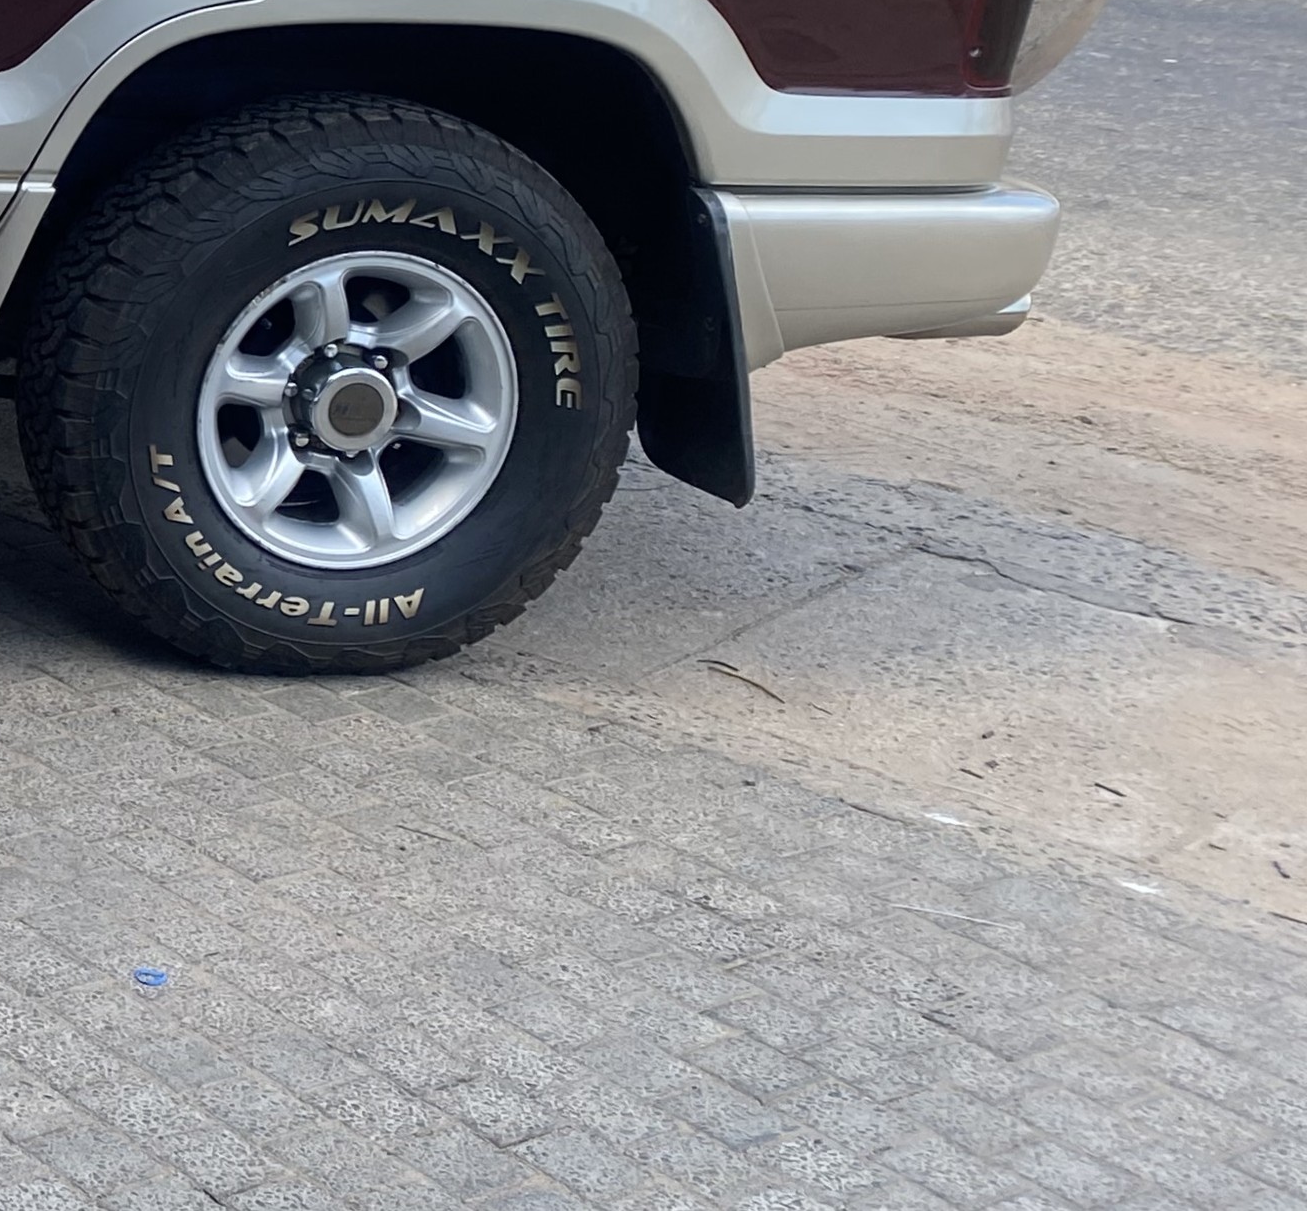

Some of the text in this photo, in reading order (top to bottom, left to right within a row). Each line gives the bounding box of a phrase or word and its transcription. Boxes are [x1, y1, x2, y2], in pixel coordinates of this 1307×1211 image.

[288, 197, 583, 411] SUMAXX TIRE
[148, 443, 425, 627] All-Terrain A/T
